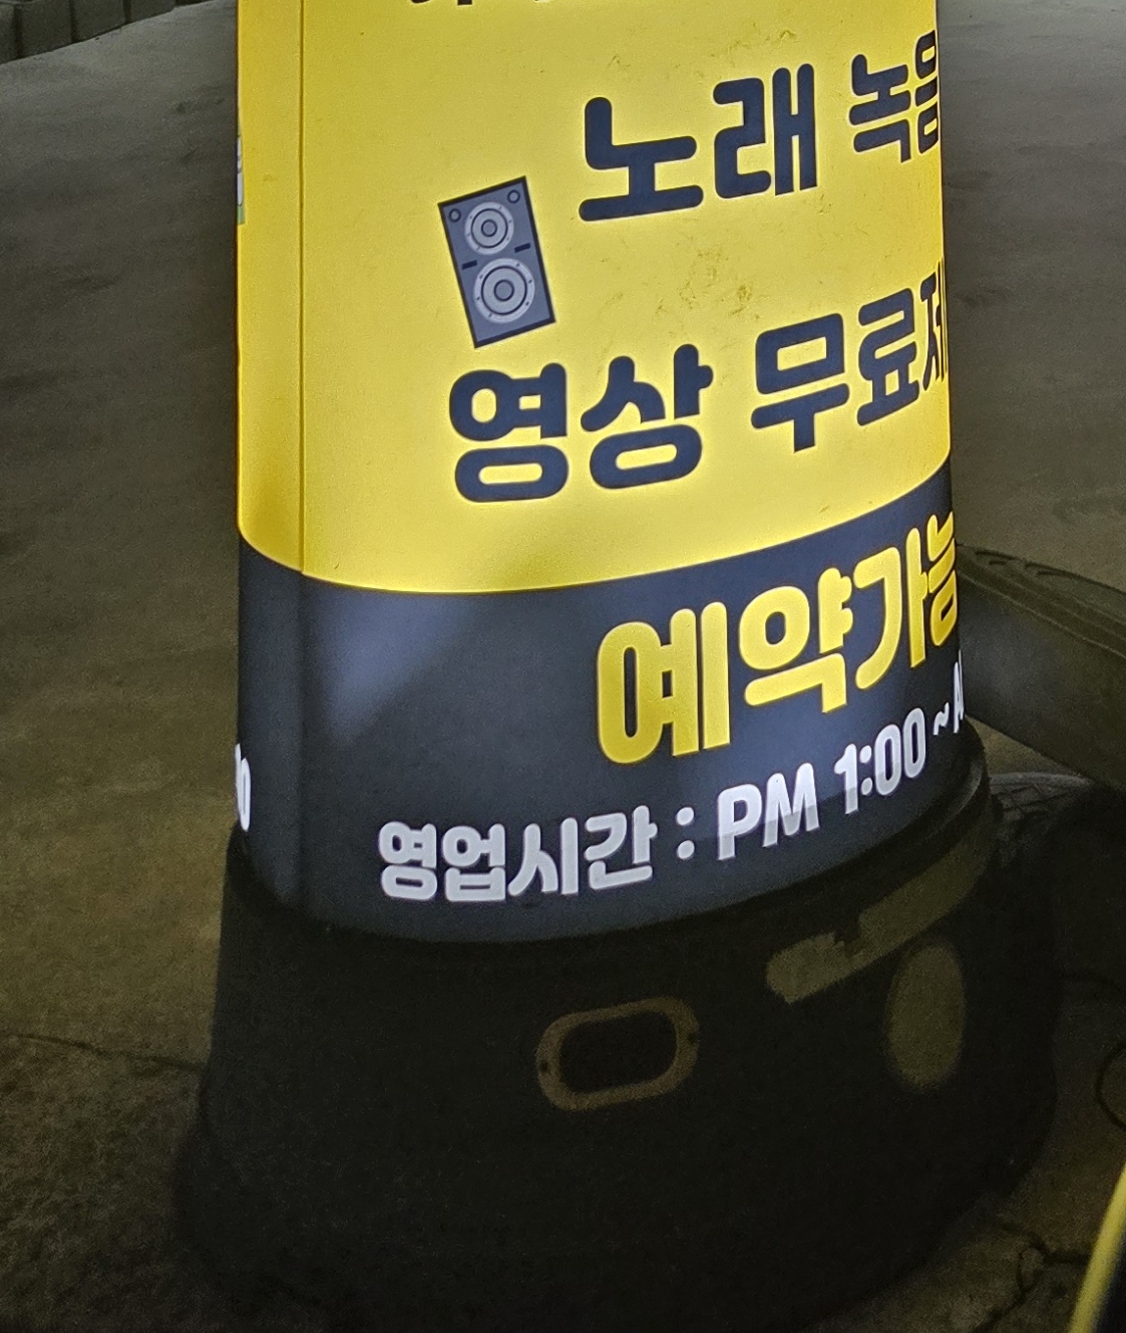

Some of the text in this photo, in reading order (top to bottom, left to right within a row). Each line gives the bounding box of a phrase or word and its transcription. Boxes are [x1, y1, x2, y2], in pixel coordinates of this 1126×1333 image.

[578, 62, 820, 222] 노래
[449, 343, 714, 503] 영상
[377, 804, 659, 903] 영업시간
[716, 763, 821, 861] PM
